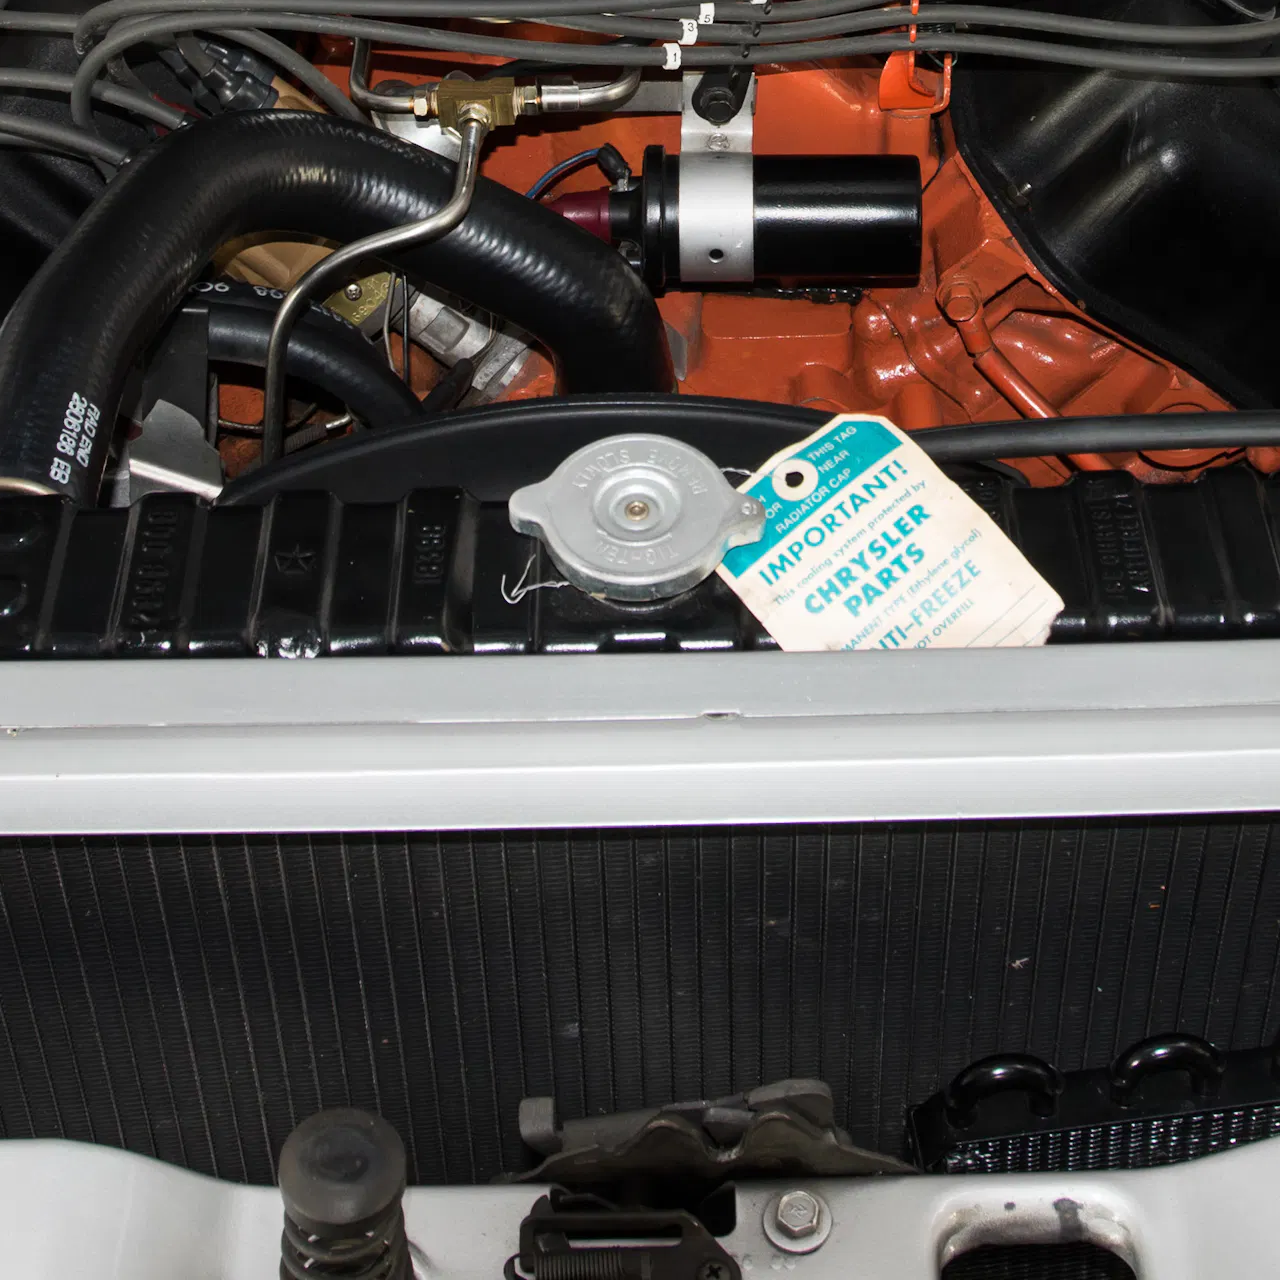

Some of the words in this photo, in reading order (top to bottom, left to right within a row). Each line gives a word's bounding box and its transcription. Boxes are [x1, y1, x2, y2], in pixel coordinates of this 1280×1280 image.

[687, 22, 694, 32] 3
[84, 403, 100, 438] RAD
[76, 434, 92, 467] END
[807, 440, 835, 465] THIS
[833, 423, 858, 446] TAG
[818, 447, 851, 477] NEAR
[774, 484, 831, 535] RADIATOR
[828, 466, 854, 490] CAP
[759, 457, 909, 587] IMPORTANT!
[774, 584, 797, 606] This
[795, 555, 834, 591] cooling
[831, 526, 870, 561] system
[865, 488, 914, 532] protected
[911, 476, 929, 495] by
[801, 499, 933, 618] CHRYSLER
[948, 528, 984, 562] glycol)
[843, 540, 928, 619] PARTS
[930, 597, 975, 638] OVERFILL
